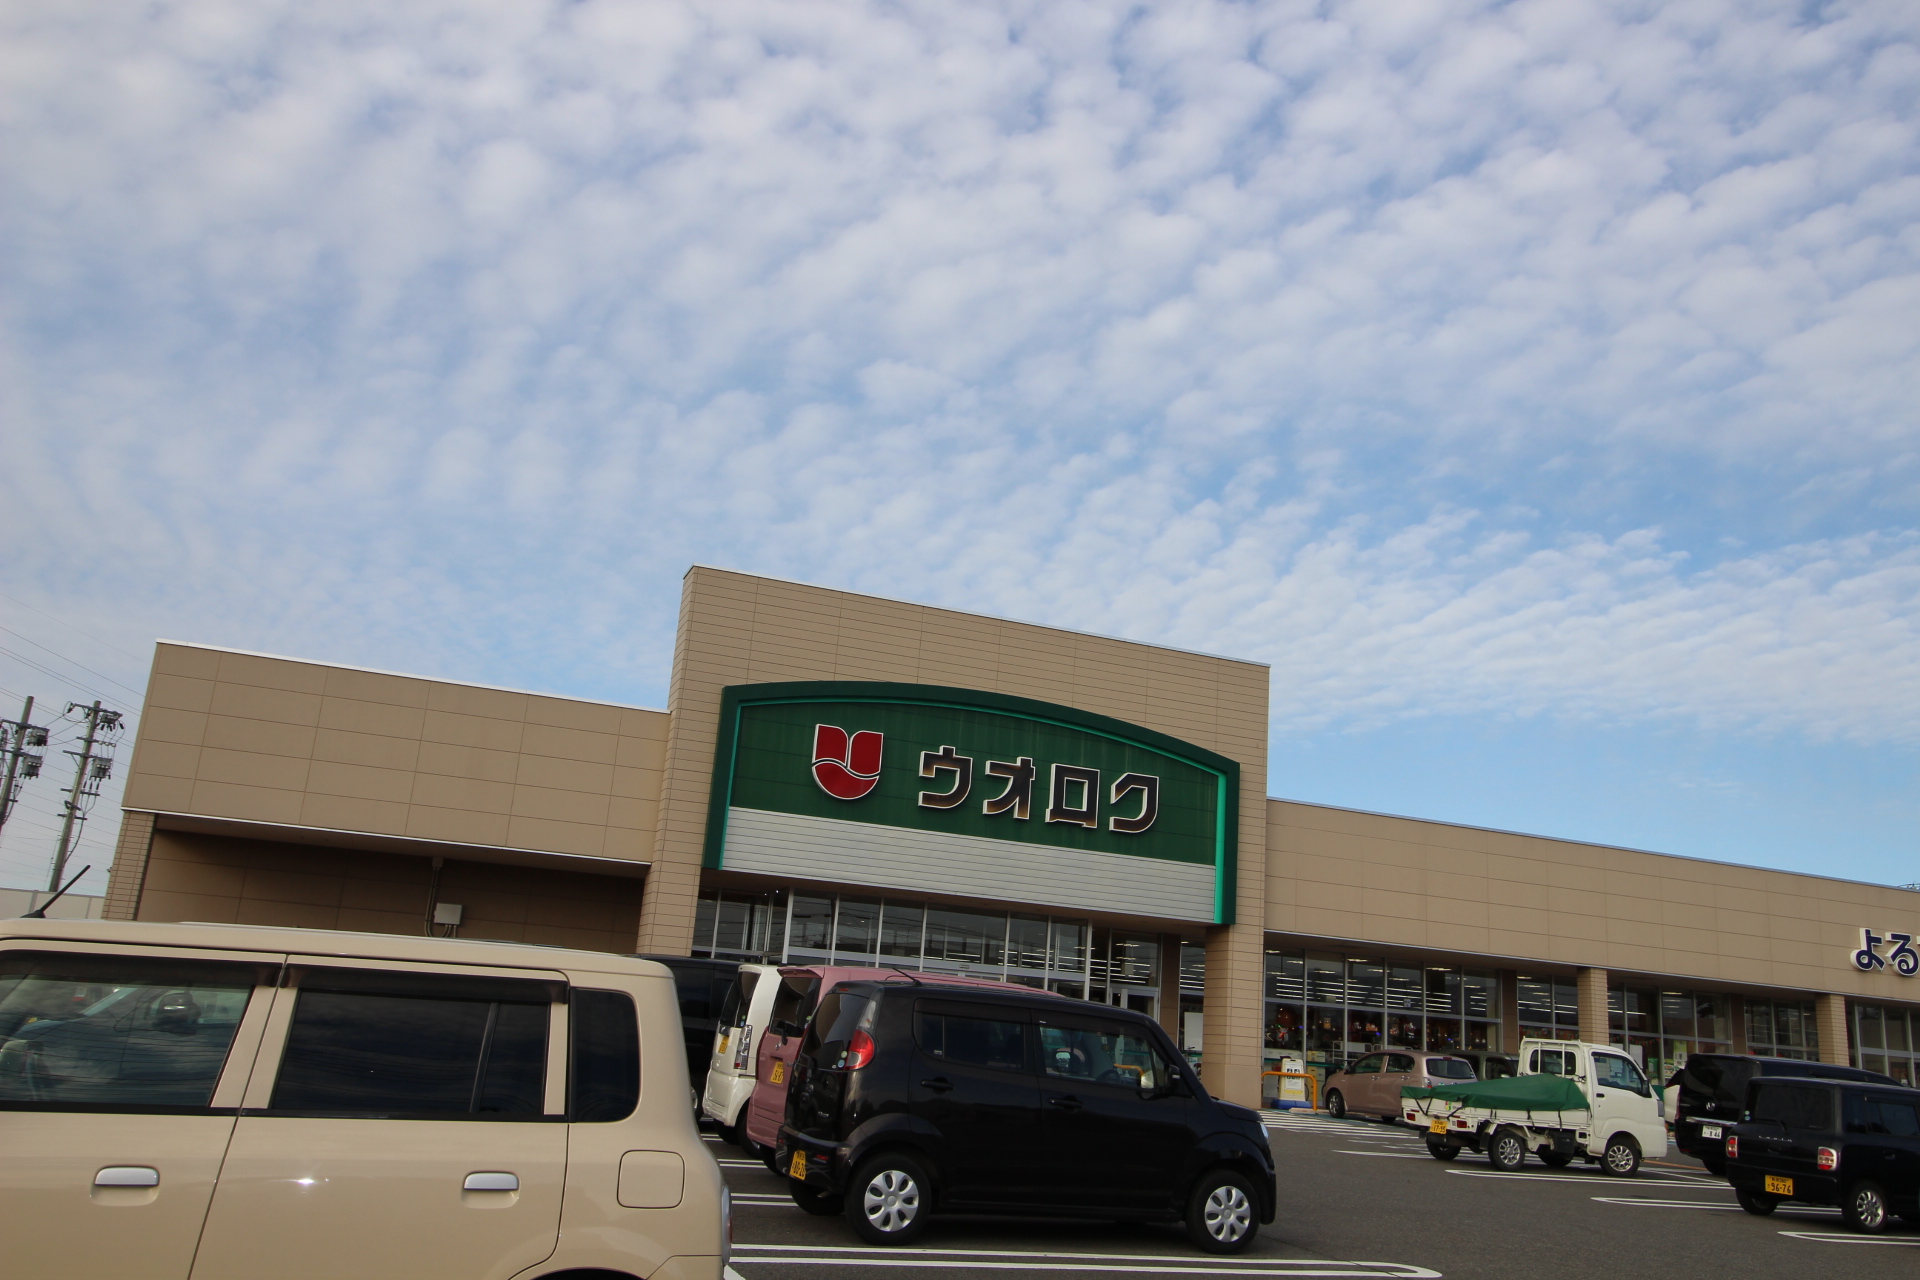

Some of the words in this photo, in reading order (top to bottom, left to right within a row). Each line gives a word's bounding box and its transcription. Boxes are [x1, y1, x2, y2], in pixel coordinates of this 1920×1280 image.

[918, 745, 1160, 834] ウオロク
[1850, 927, 1920, 976] よる
[1770, 1182, 1792, 1194] 96-76
